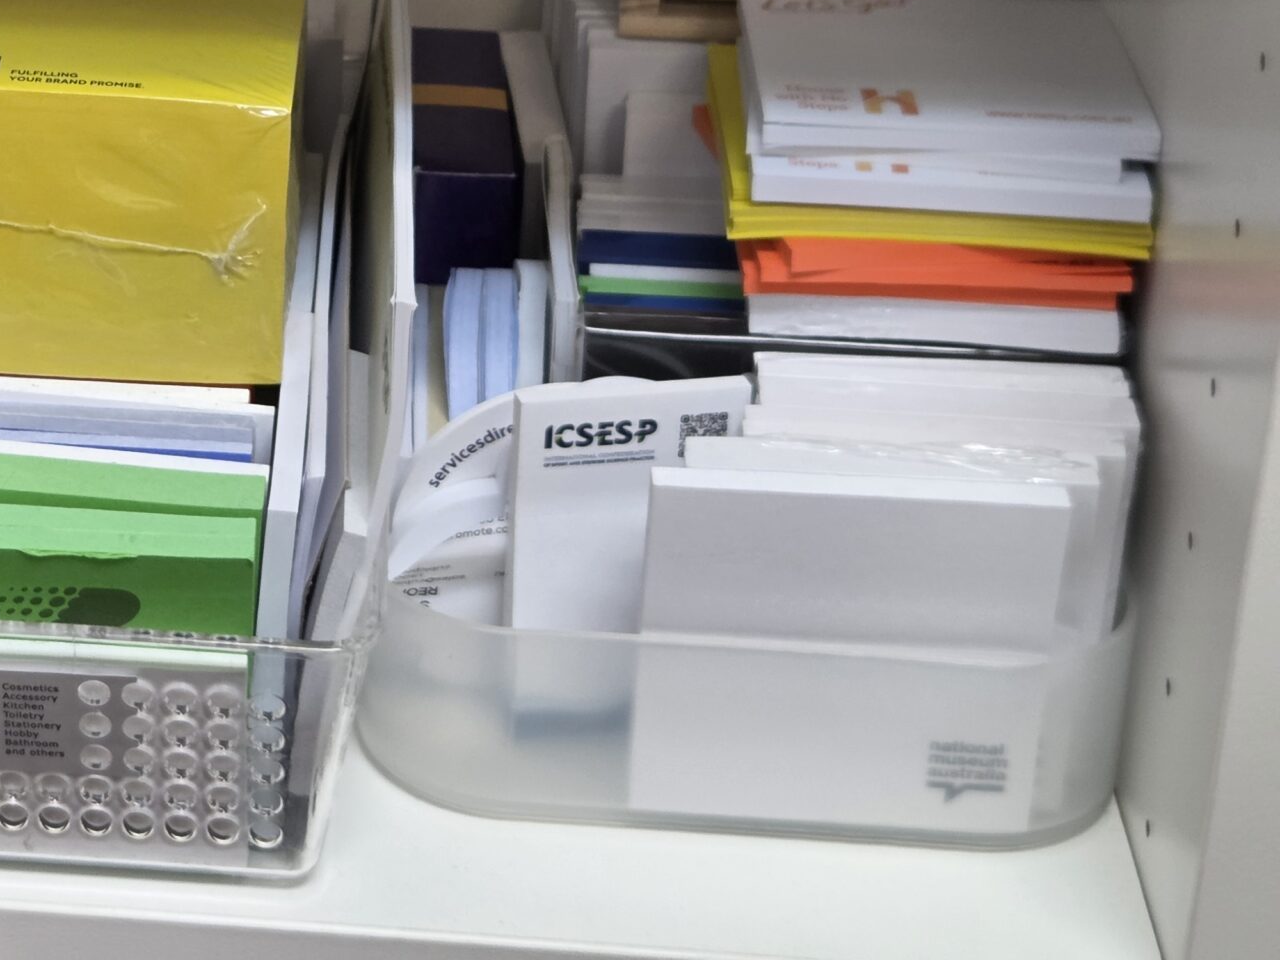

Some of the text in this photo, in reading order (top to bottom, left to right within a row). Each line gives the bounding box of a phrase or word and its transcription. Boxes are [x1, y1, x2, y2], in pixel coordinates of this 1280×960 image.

[10, 69, 79, 79] FULFILLING
[45, 77, 88, 86] BRAND
[544, 418, 658, 449] ICSESP
[1, 683, 60, 693] Cosmetics
[1, 692, 58, 703] Accessory
[3, 702, 45, 711] Kitchen
[3, 711, 45, 721] Toiletry
[3, 720, 62, 731] Stationery
[4, 729, 40, 739] Hobby
[5, 738, 60, 748] Bathroom
[5, 748, 65, 758] and others
